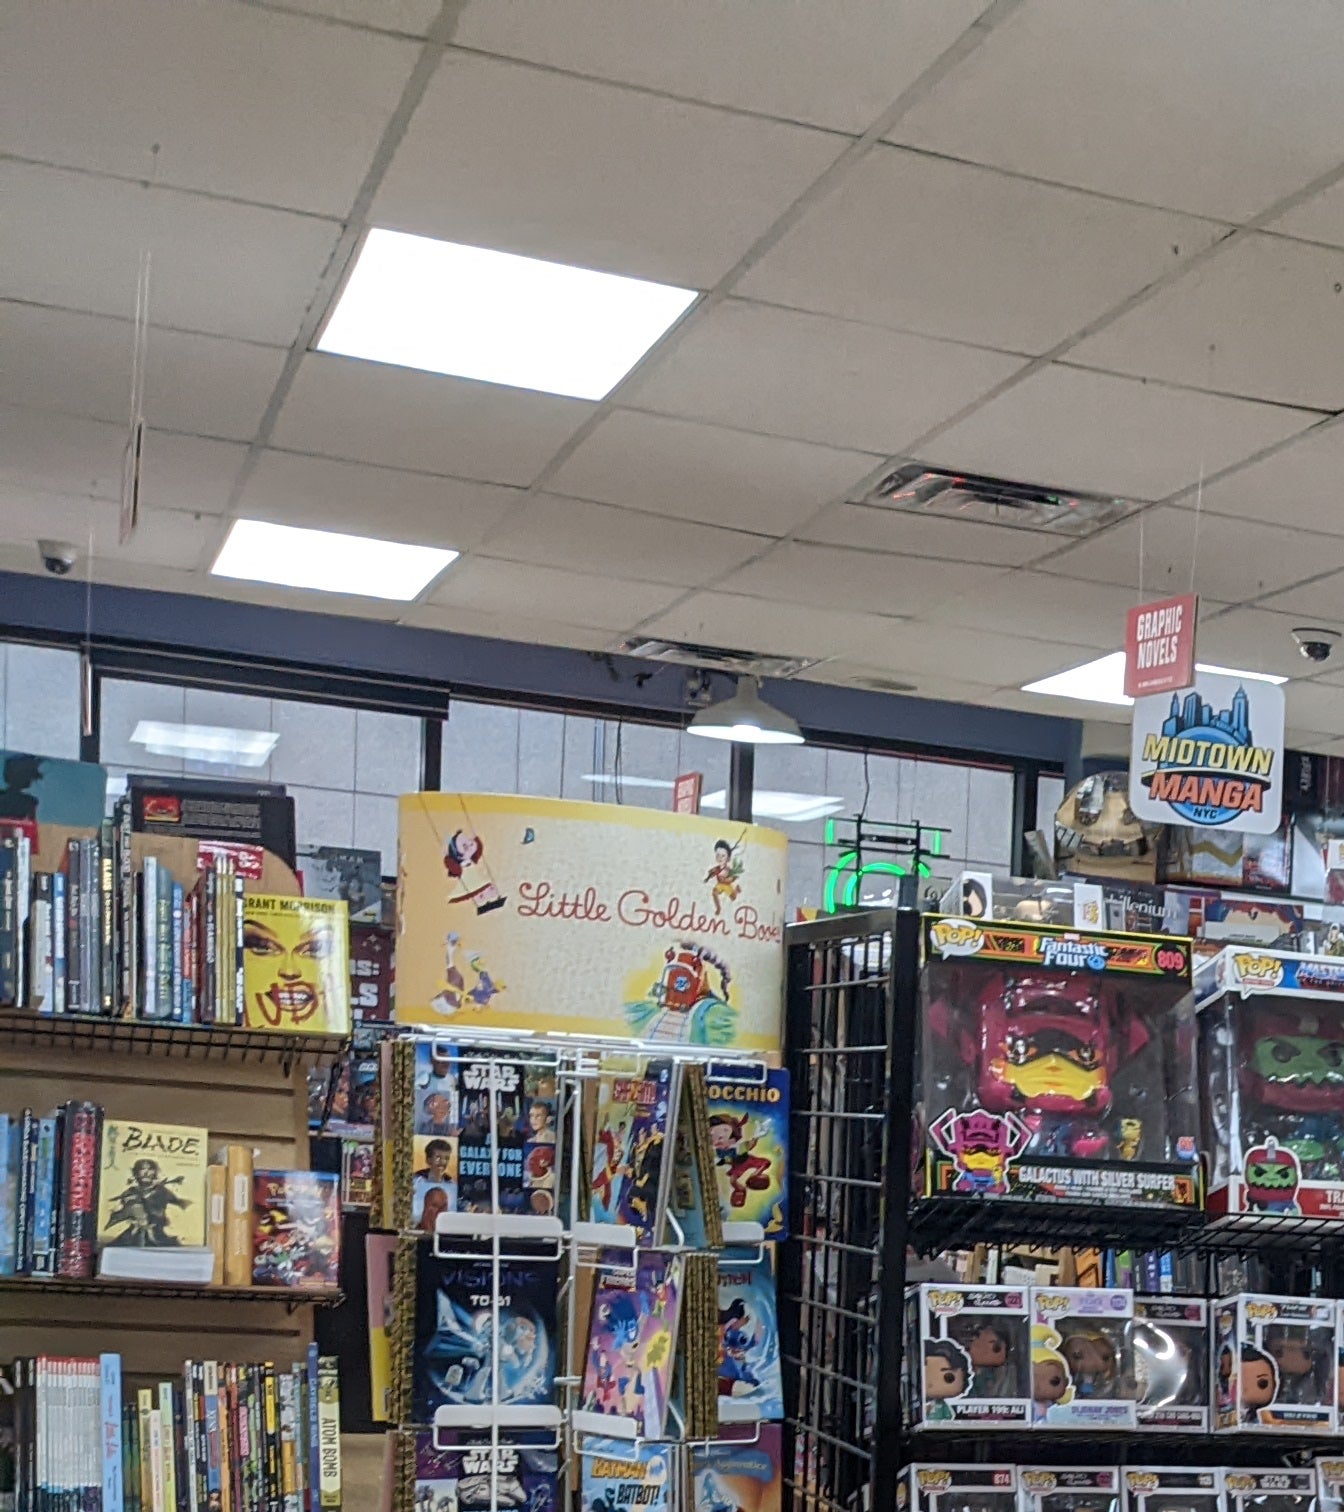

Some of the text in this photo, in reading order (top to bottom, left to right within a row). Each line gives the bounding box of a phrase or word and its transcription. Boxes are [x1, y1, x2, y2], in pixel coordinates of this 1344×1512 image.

[1137, 605, 1183, 641] GRAPHIC
[1137, 636, 1177, 669] NOVELS
[1143, 734, 1274, 777] MIDTOWN
[1149, 772, 1263, 813] MANGA
[1193, 806, 1219, 819] NYC
[243, 899, 336, 915] GRANT MORRISON
[517, 882, 730, 936] Little Golden
[932, 920, 1185, 971] POP! Fantastic 809
[1043, 949, 1087, 968] Four
[1236, 954, 1282, 979] POP!
[463, 1063, 519, 1078] STAR
[462, 1075, 520, 1092] WARS
[502, 1147, 523, 1161] FOR
[1018, 1167, 1176, 1191] GALACTUS WITH SILVER SURFER
[322, 1416, 337, 1479] ATOM BOMB
[462, 1458, 519, 1474] WARS
[591, 1459, 648, 1480] BATMAN
